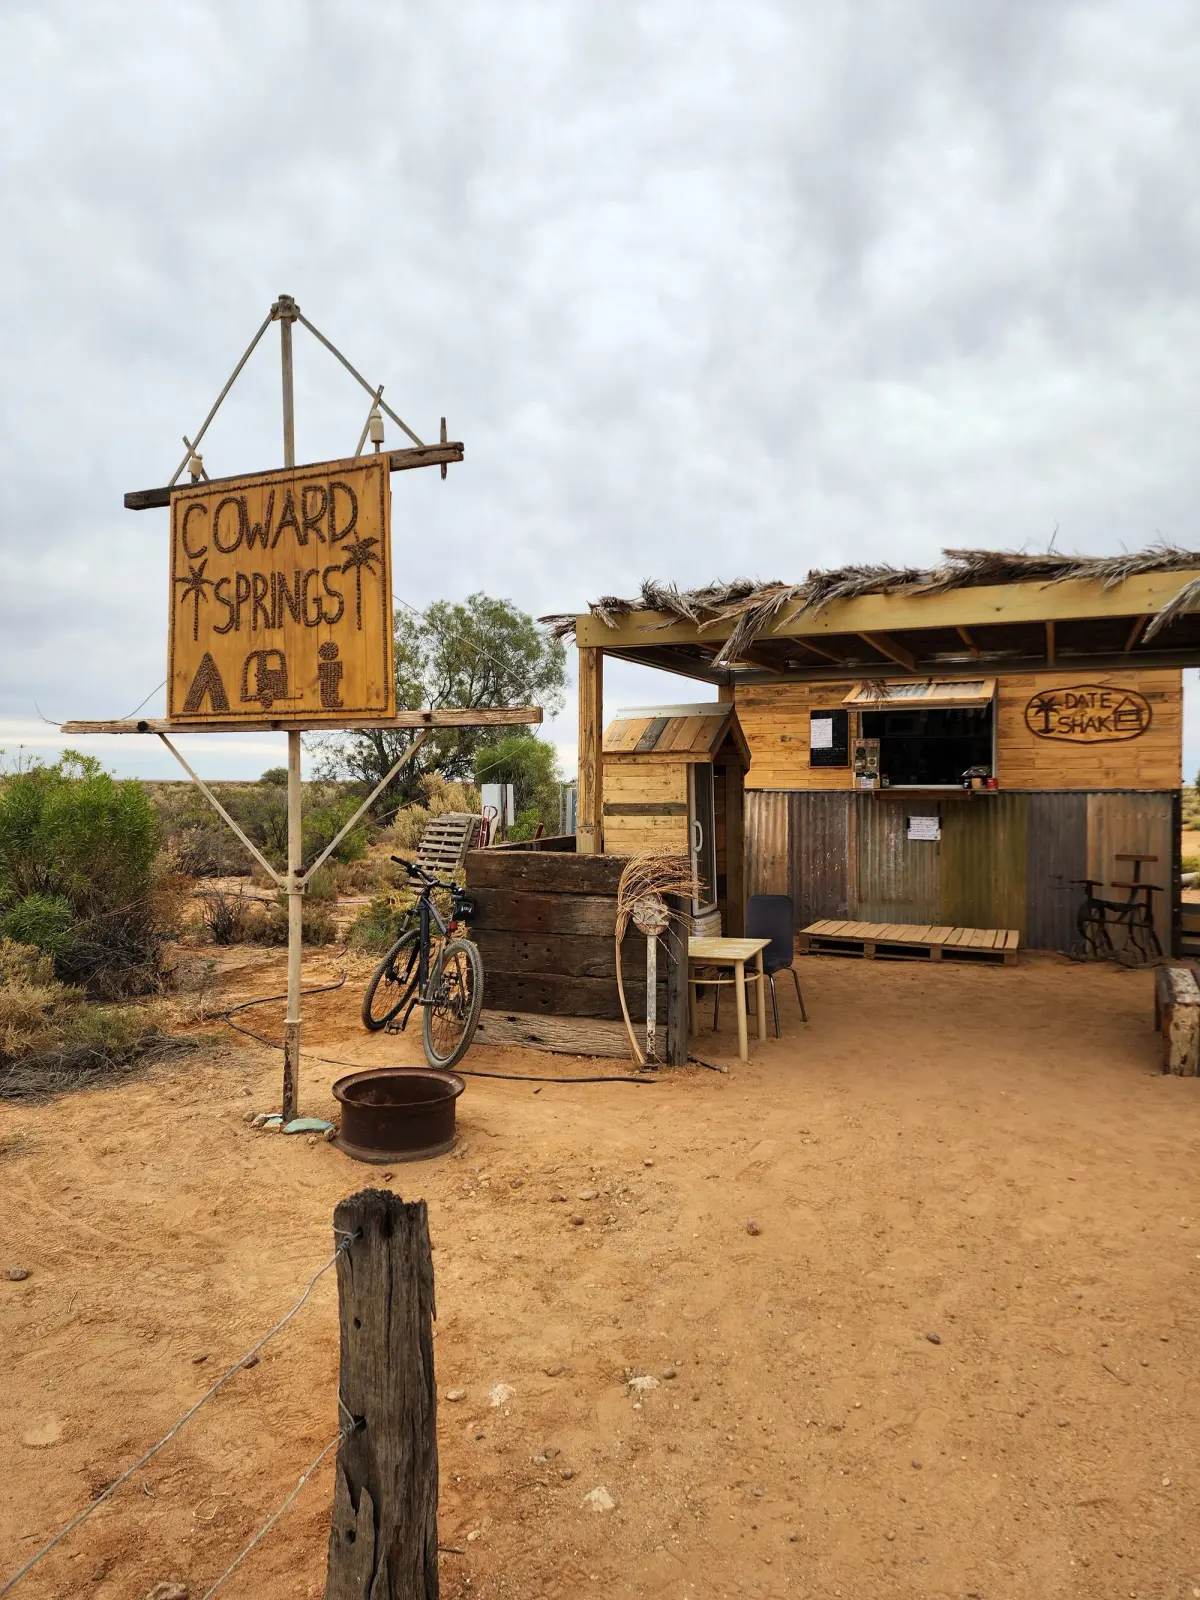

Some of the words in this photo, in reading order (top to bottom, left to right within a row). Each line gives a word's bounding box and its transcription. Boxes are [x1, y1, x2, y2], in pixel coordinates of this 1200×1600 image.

[182, 481, 358, 559] COWARD
[213, 564, 344, 634] SPRINGS
[1065, 693, 1112, 710] DATE
